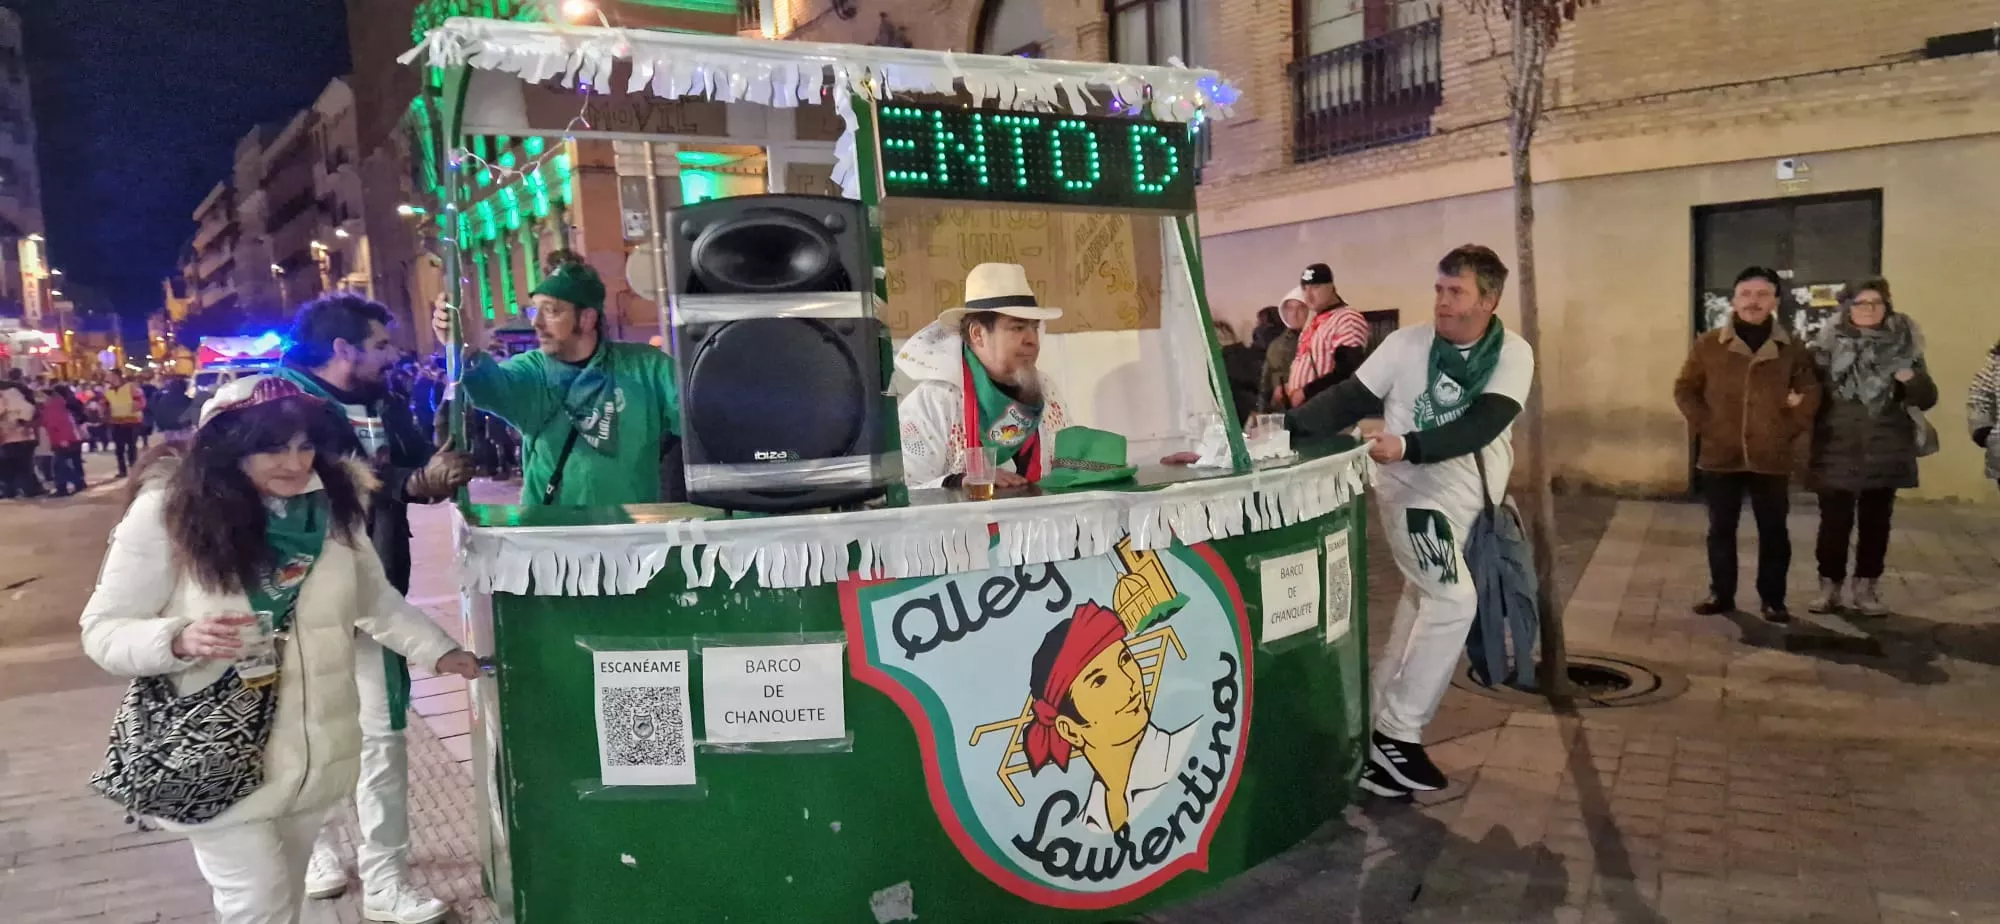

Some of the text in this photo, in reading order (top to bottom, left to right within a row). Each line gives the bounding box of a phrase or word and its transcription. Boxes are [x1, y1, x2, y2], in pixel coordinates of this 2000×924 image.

[1130, 124, 1180, 193] D
[754, 451, 787, 460] ibiza
[1280, 564, 1304, 579] BARCO
[1287, 586, 1297, 599] DE
[1271, 602, 1313, 624] CHANQUETE
[600, 658, 682, 673] ESCANÉAME
[745, 658, 801, 673] BARCO
[763, 684, 785, 698] DE
[724, 707, 826, 724] CHANQUETE
[1011, 651, 1239, 882] Laurentina
